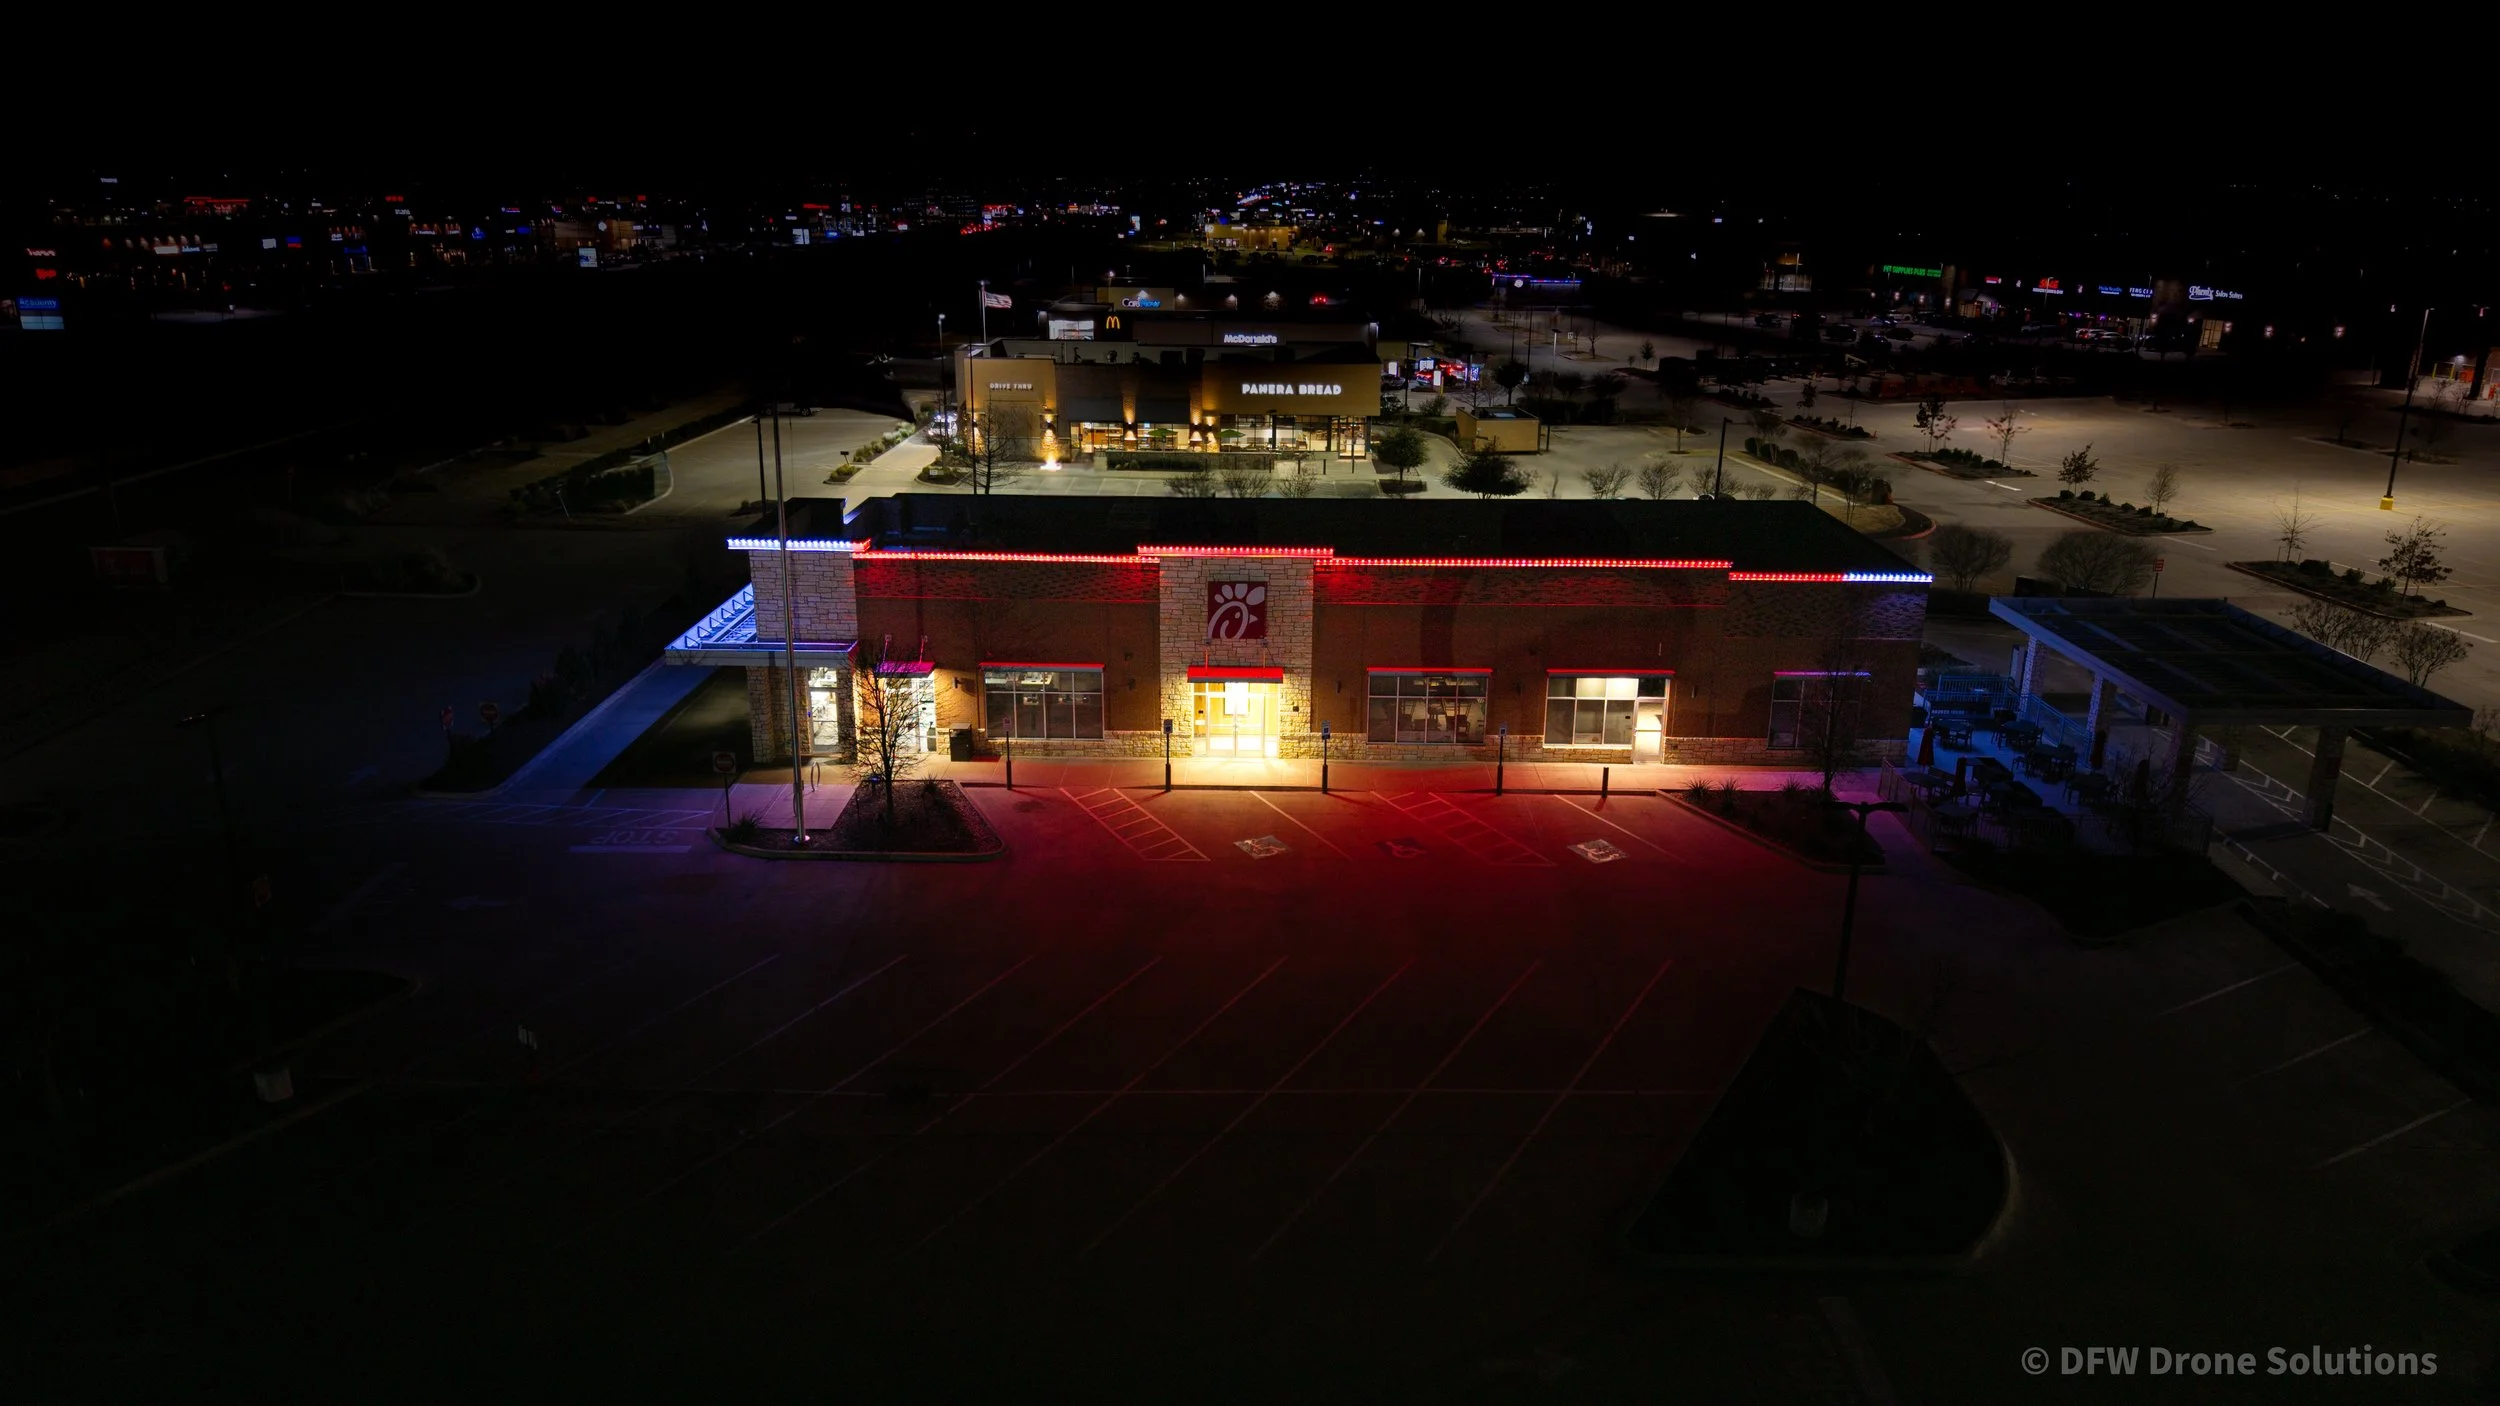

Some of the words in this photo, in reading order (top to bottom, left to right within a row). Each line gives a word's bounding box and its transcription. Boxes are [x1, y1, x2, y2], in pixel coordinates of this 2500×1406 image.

[1223, 334, 1277, 344] McDonald's
[1241, 383, 1294, 395] PANERA
[1298, 384, 1342, 396] BREAD
